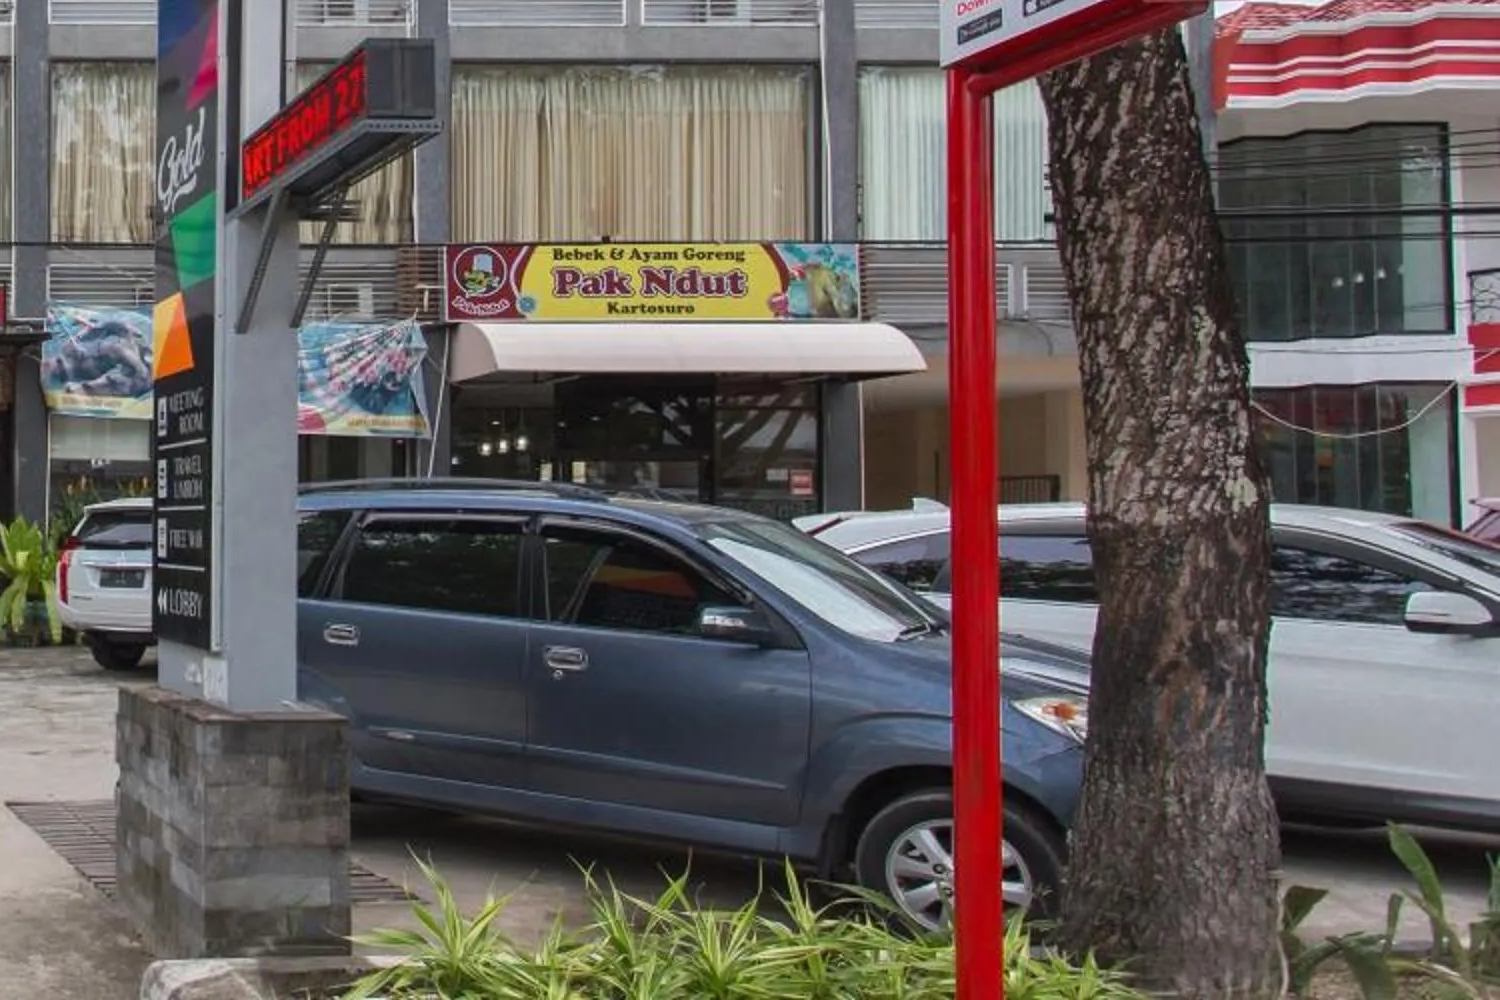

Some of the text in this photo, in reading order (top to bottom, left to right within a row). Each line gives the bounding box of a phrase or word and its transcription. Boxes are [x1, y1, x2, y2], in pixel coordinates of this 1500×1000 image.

[277, 92, 332, 168] FROM
[157, 106, 205, 213] Gold
[553, 247, 746, 263] Bebek & Ayam Goreng
[551, 265, 749, 297] Pak Ndut
[607, 301, 695, 315] Kartosuro
[169, 587, 203, 619] LOBBY
